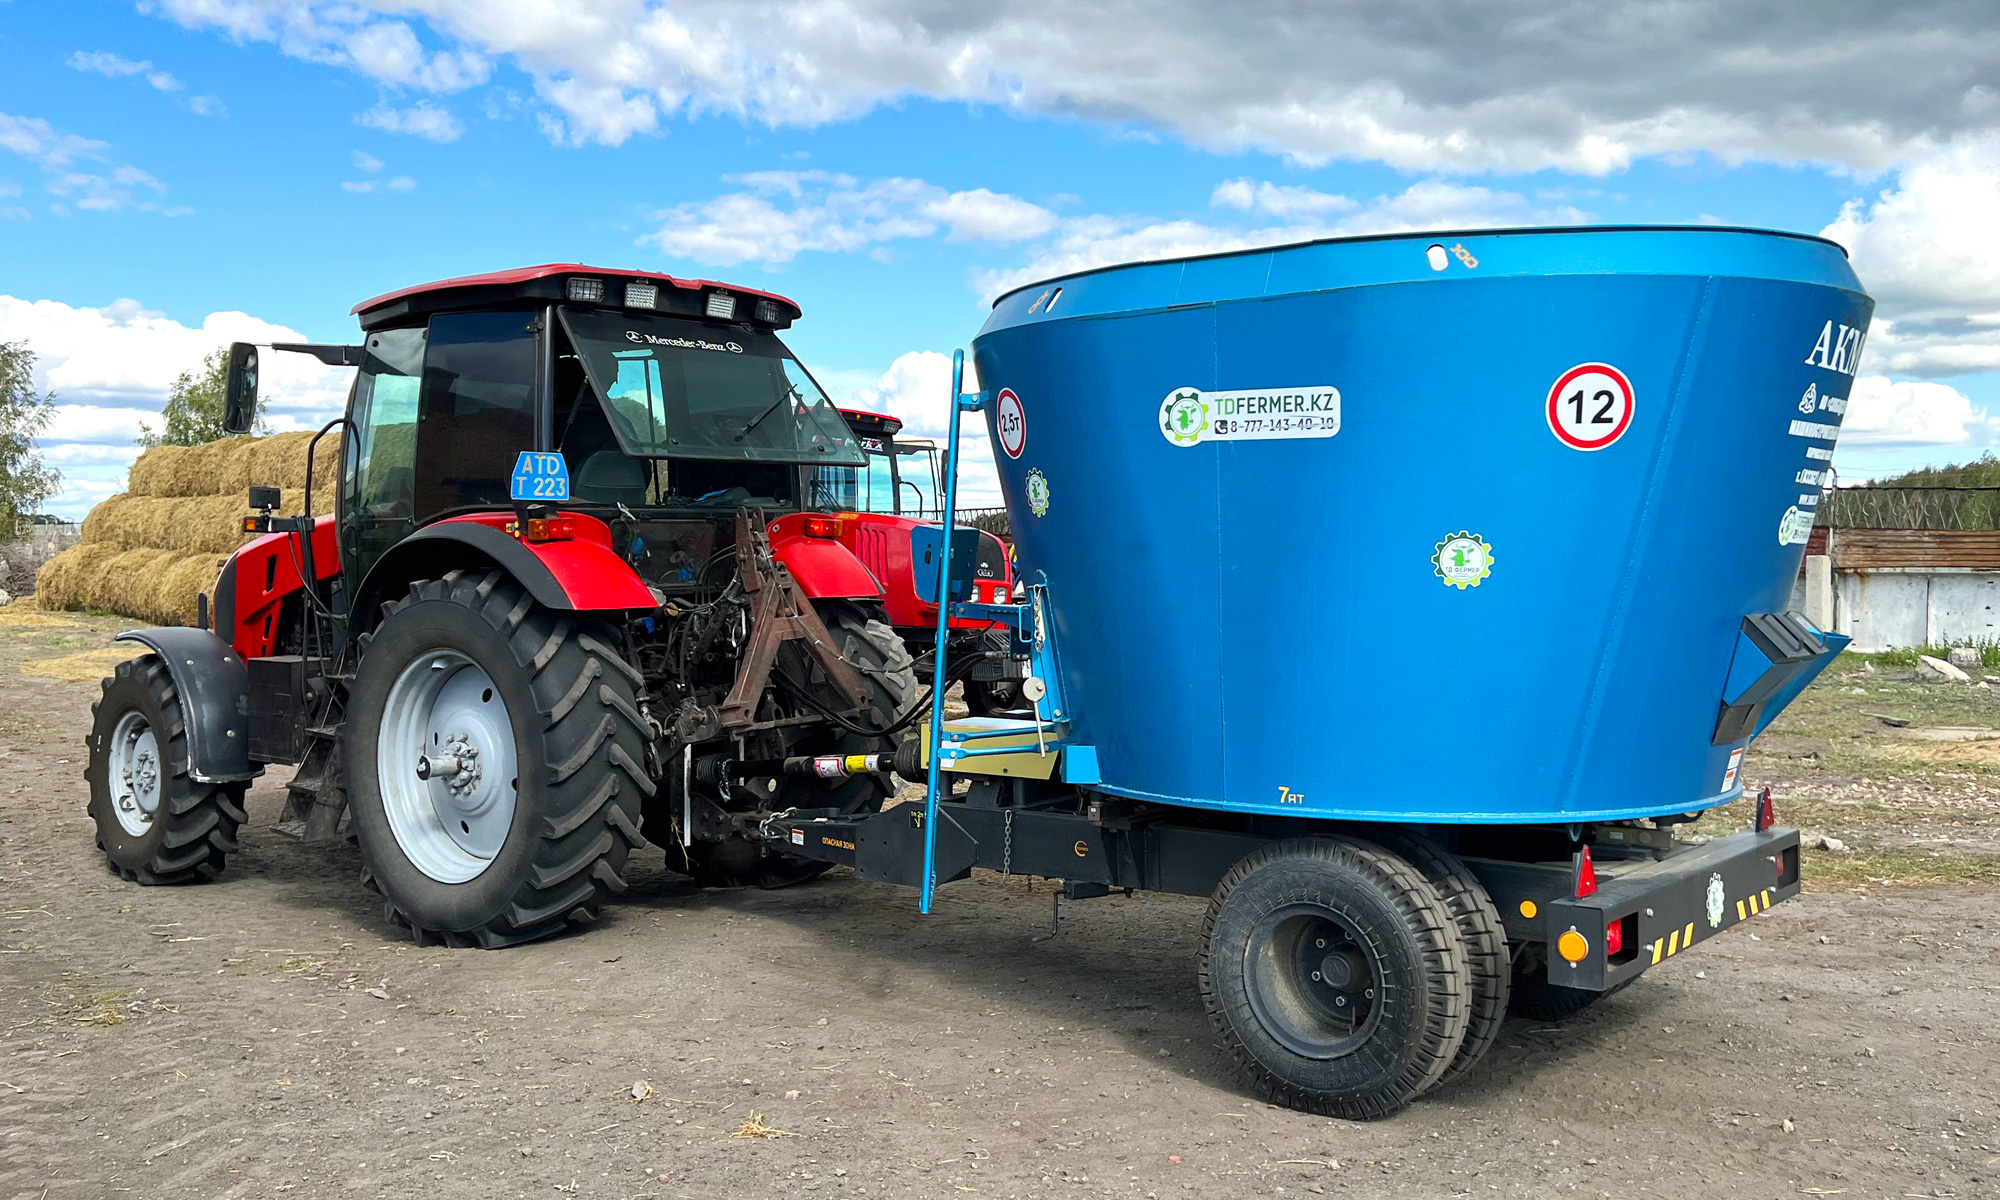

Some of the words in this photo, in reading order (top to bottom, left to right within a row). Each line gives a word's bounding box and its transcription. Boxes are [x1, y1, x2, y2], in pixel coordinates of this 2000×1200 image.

[1214, 393, 1334, 415] TDFERMER.KZ
[1567, 389, 1615, 424] 12
[1230, 417, 1334, 433] 8-777-143-40-10
[521, 455, 560, 476] ATD
[515, 476, 528, 496] T
[533, 477, 566, 497] 223
